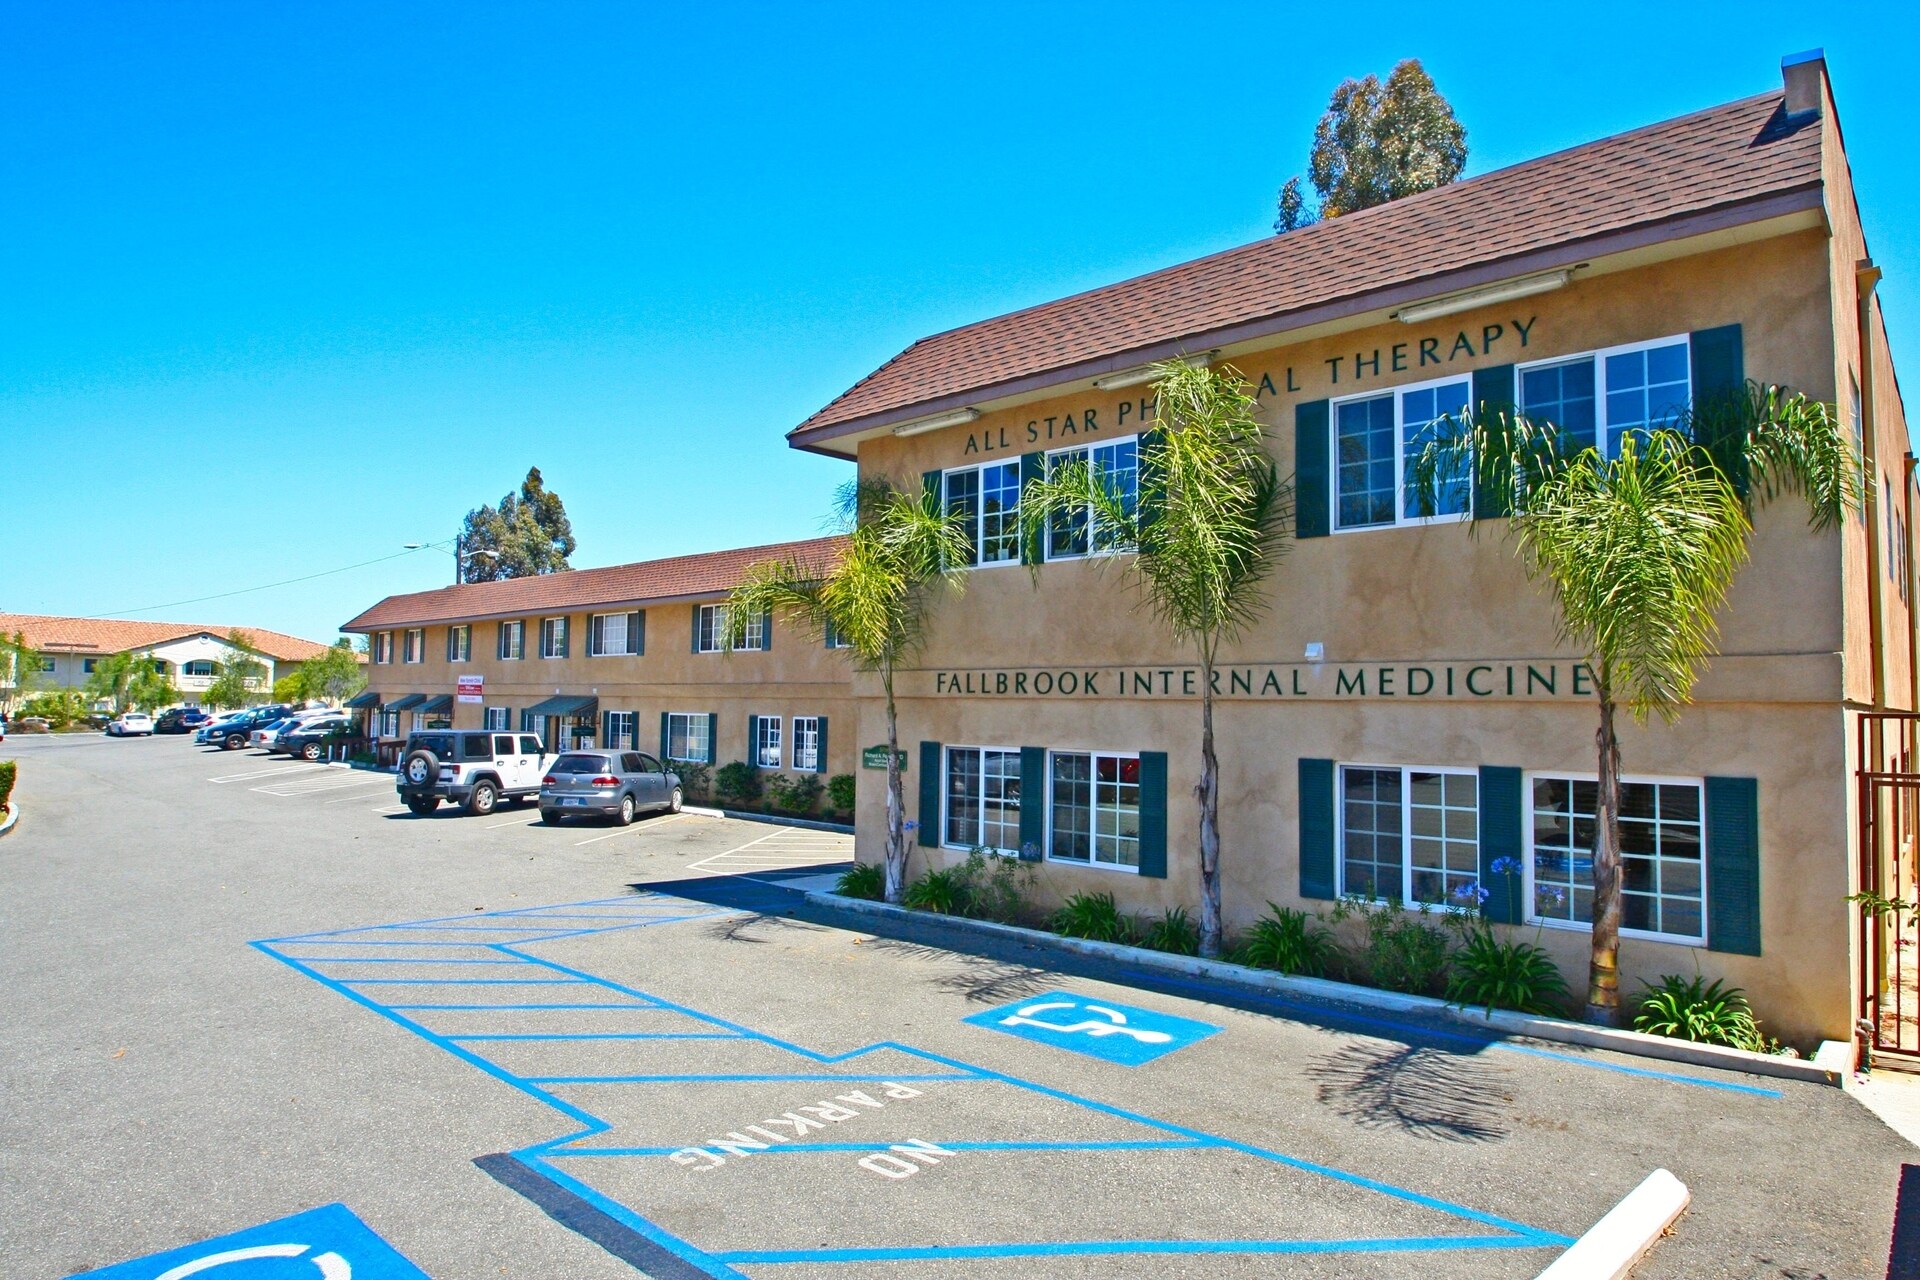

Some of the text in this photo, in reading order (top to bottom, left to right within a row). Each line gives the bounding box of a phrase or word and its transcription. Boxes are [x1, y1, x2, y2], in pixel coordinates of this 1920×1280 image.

[964, 316, 1537, 455] ALL STAR PHAL THERAPY
[936, 663, 1593, 696] FALLBROOK INTERNAL MEDICINE
[669, 1081, 924, 1172] PARKING
[858, 1138, 957, 1180] NO
